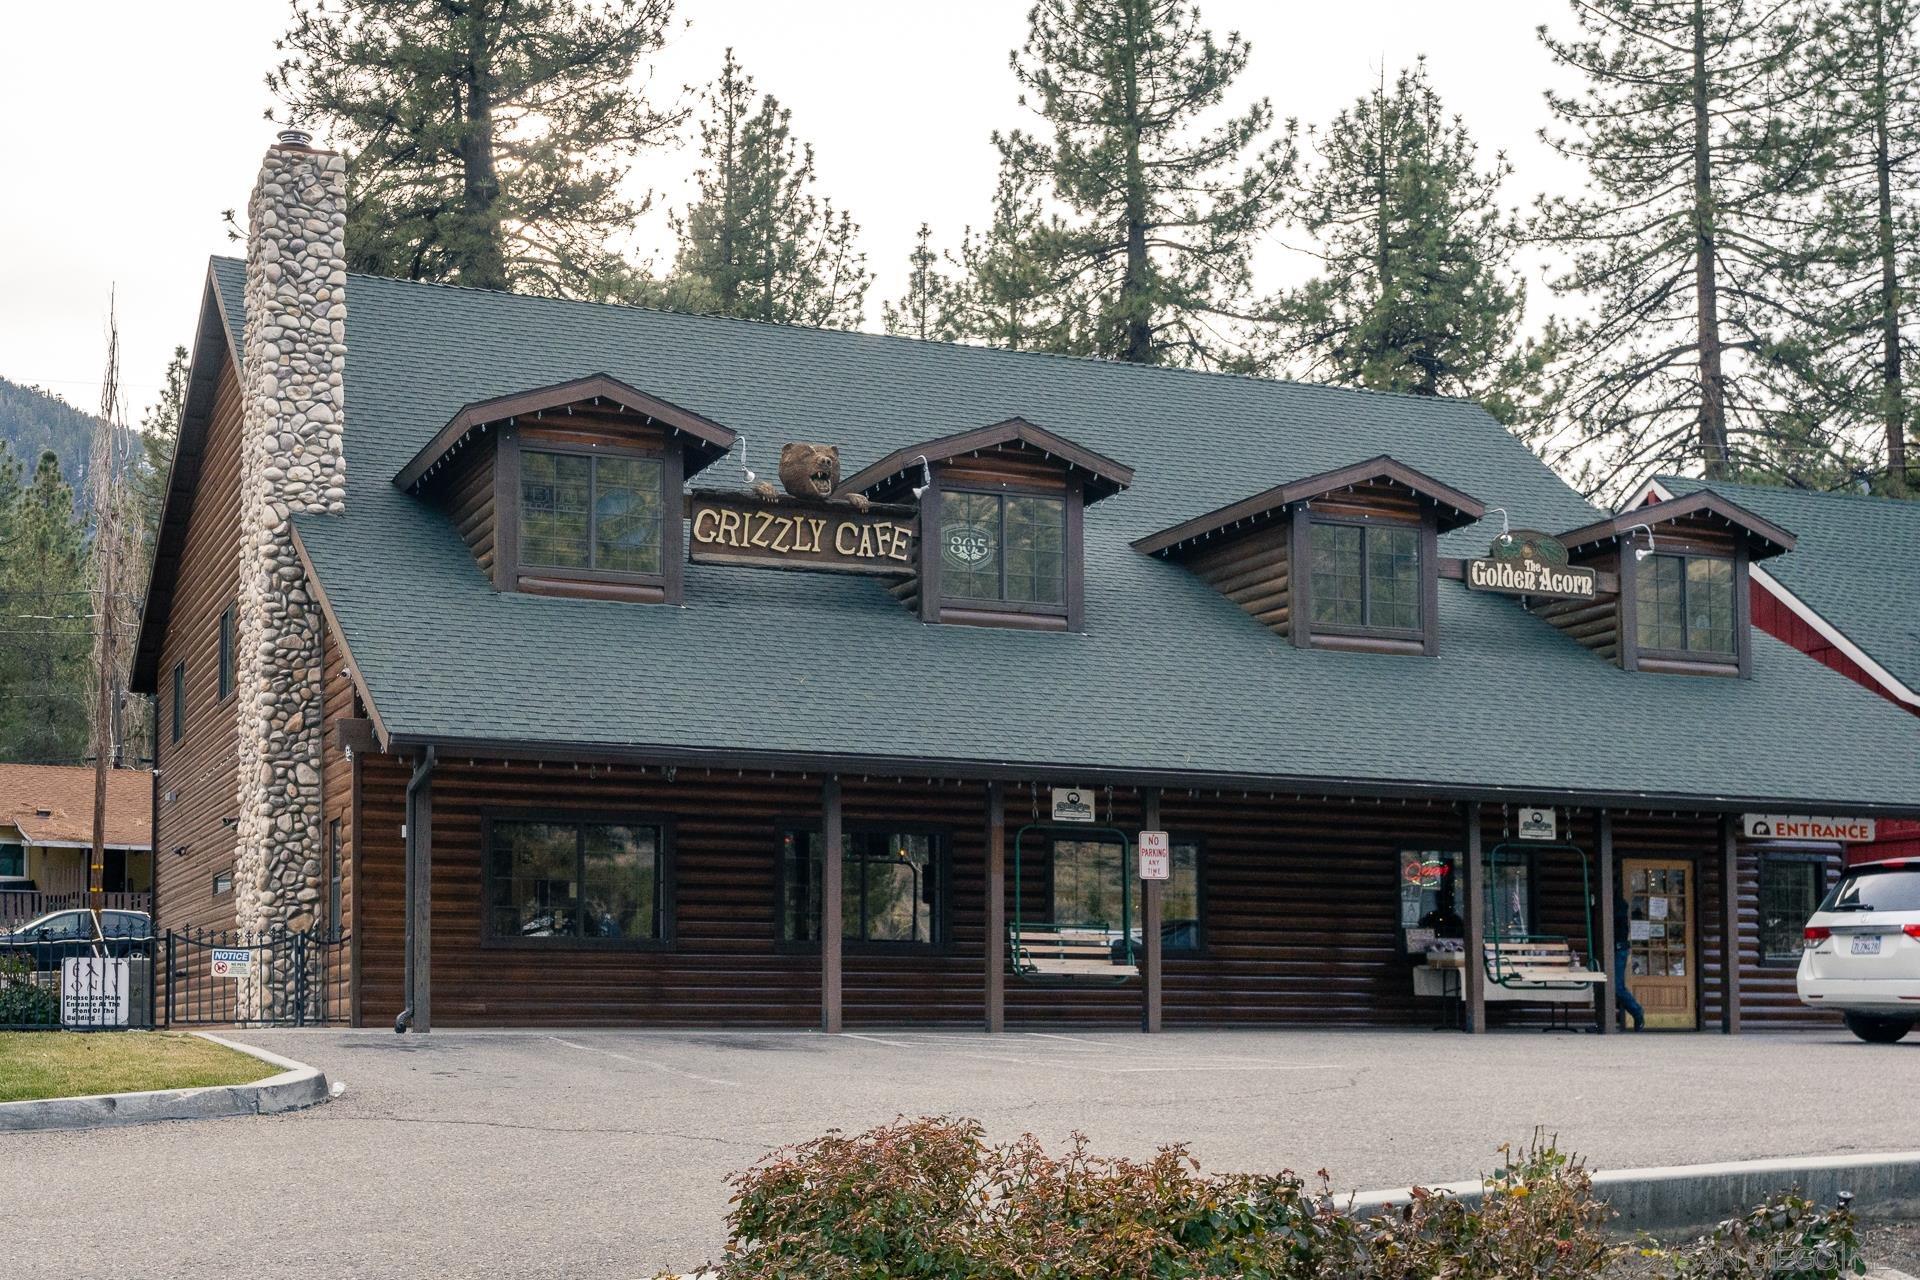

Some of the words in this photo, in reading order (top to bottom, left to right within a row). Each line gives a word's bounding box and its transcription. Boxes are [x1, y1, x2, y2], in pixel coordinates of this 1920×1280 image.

[693, 508, 826, 553] GRIZZLY
[835, 521, 912, 561] CAFE
[950, 536, 987, 556] 805
[1524, 559, 1541, 572] The
[1472, 560, 1536, 591] Golden
[1538, 567, 1593, 596] Acorn
[1775, 822, 1869, 839] ENTRANCE
[1148, 836, 1160, 846] NO
[1141, 848, 1167, 857] PARKING
[214, 951, 249, 961] NOTICE
[72, 962, 123, 978] EXT
